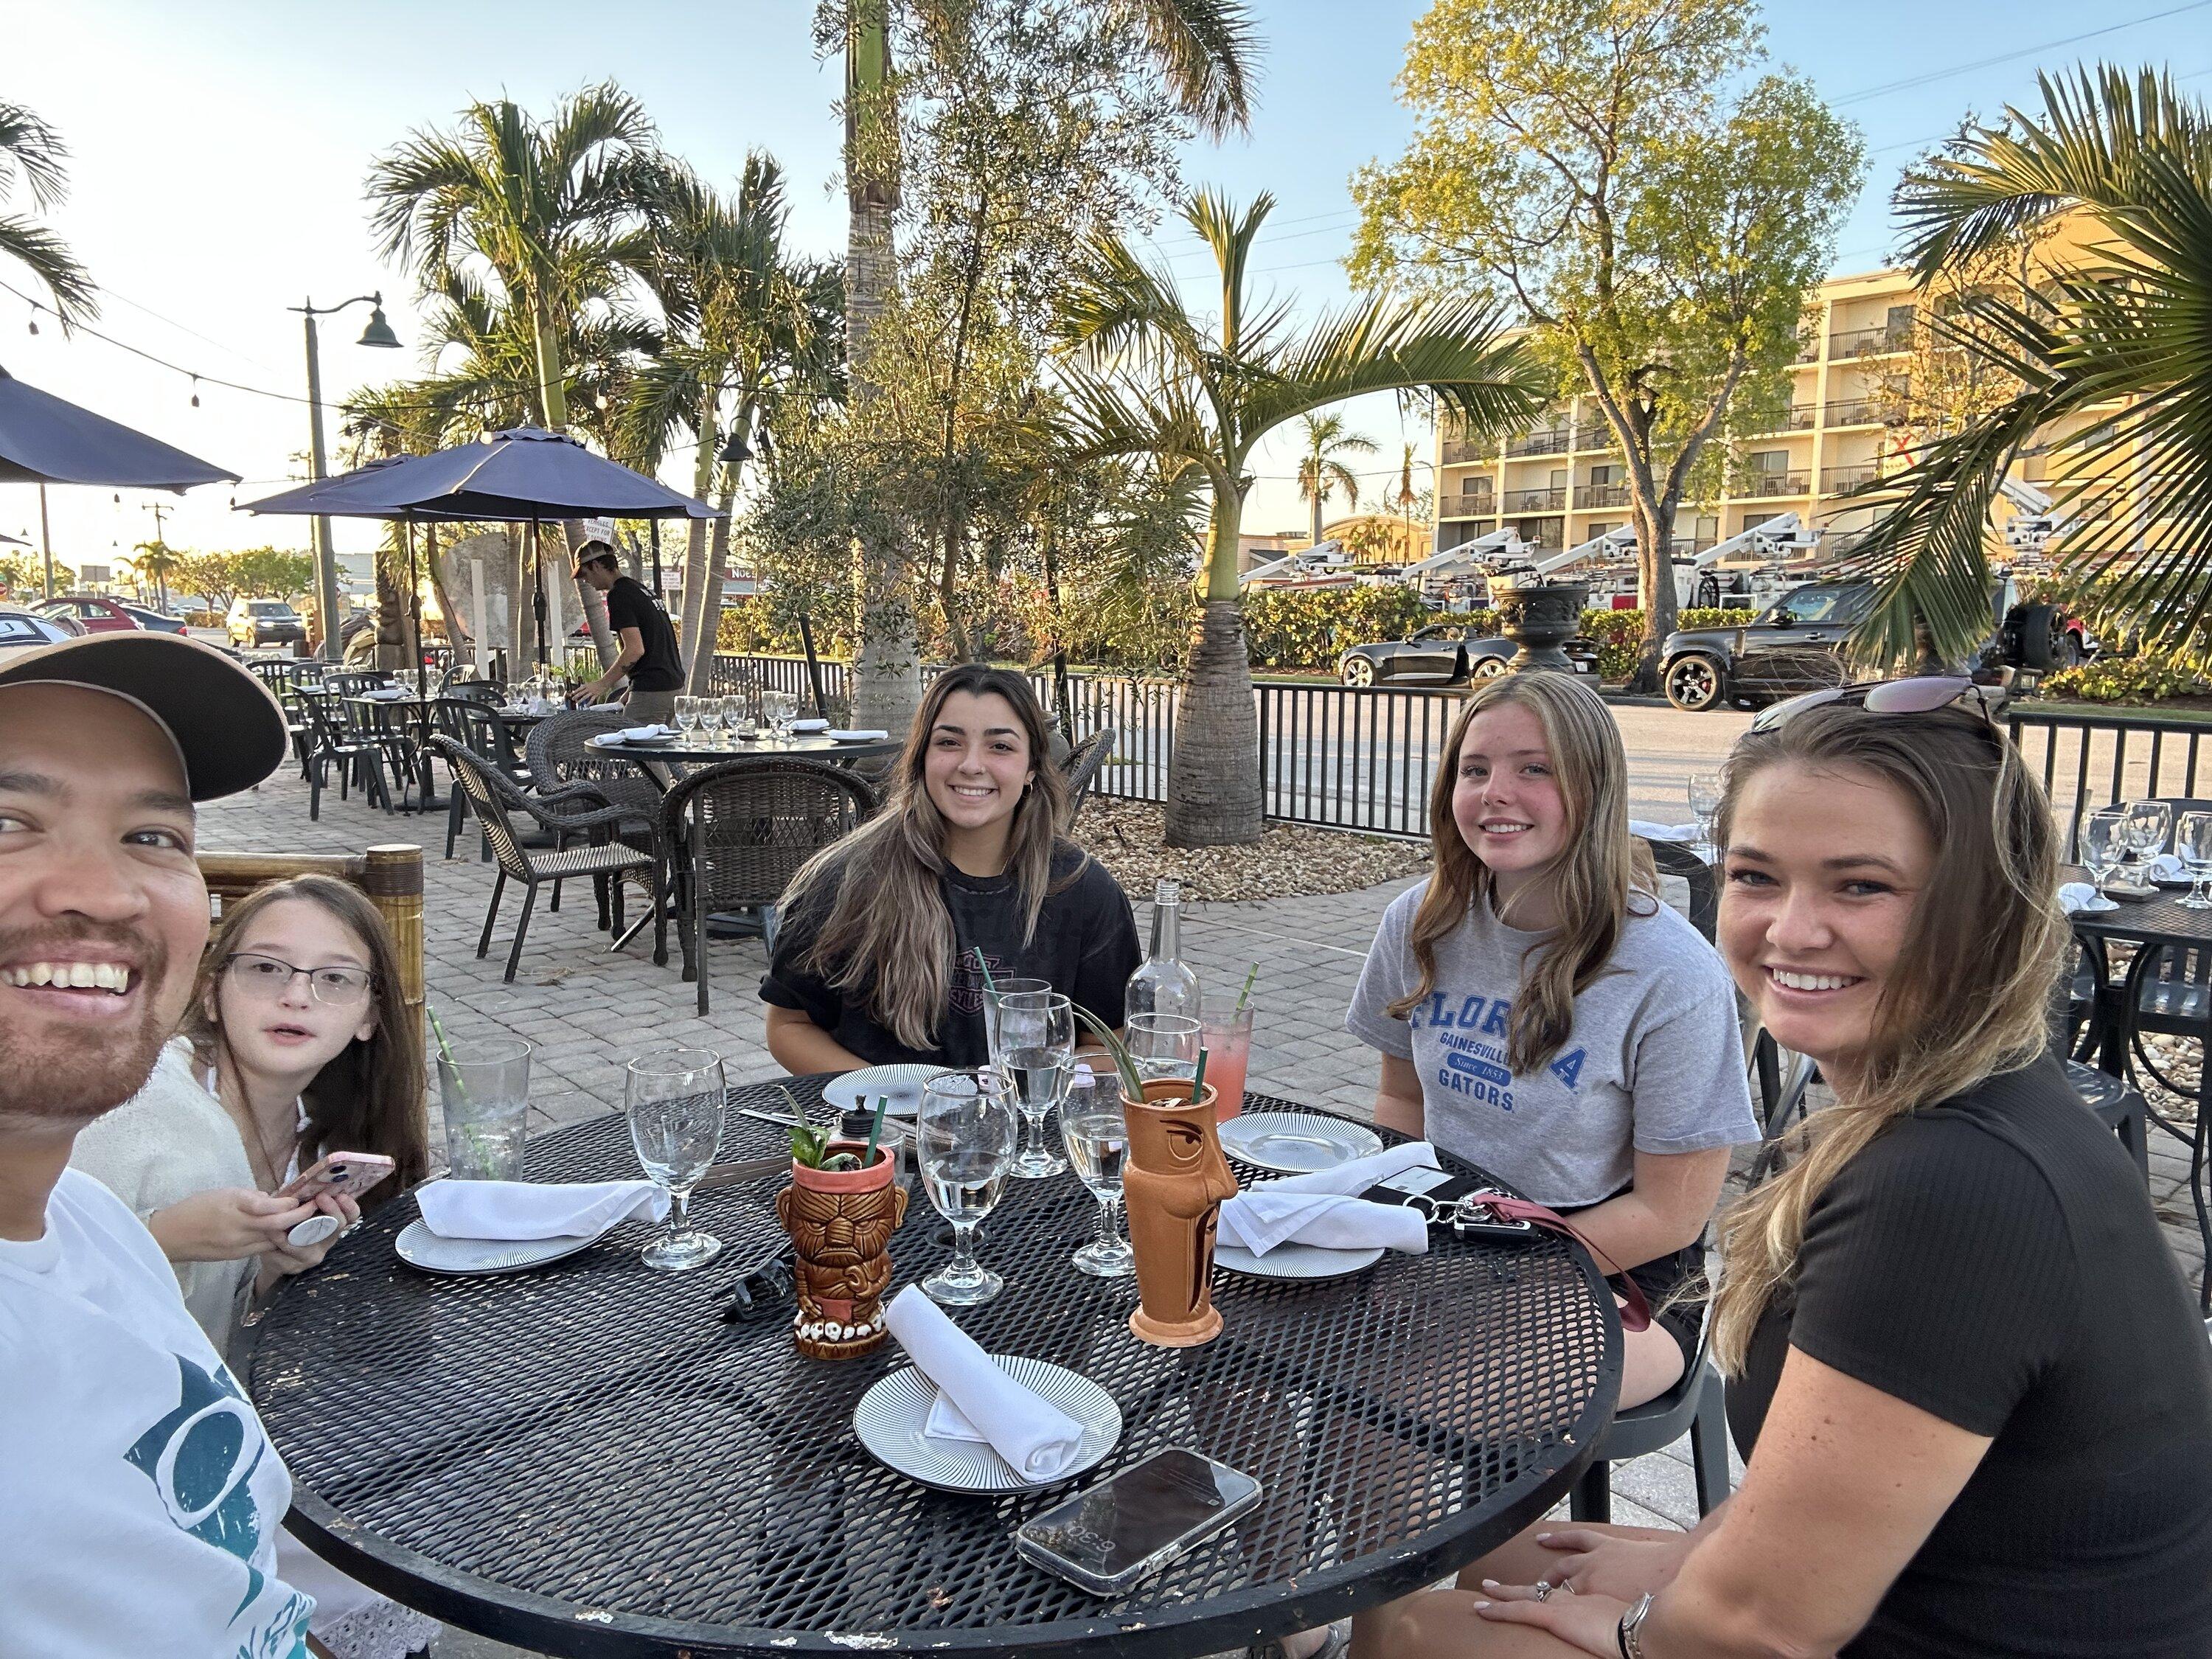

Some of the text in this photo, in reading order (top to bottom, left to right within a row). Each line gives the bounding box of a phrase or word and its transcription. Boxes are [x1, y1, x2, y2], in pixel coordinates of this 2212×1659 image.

[1439, 1032, 1512, 1066] GAINESVILL
[1455, 1056, 1503, 1081] Since 1853
[1439, 1068, 1514, 1112] GATORS
[1067, 1526, 1116, 1553] 6:30
